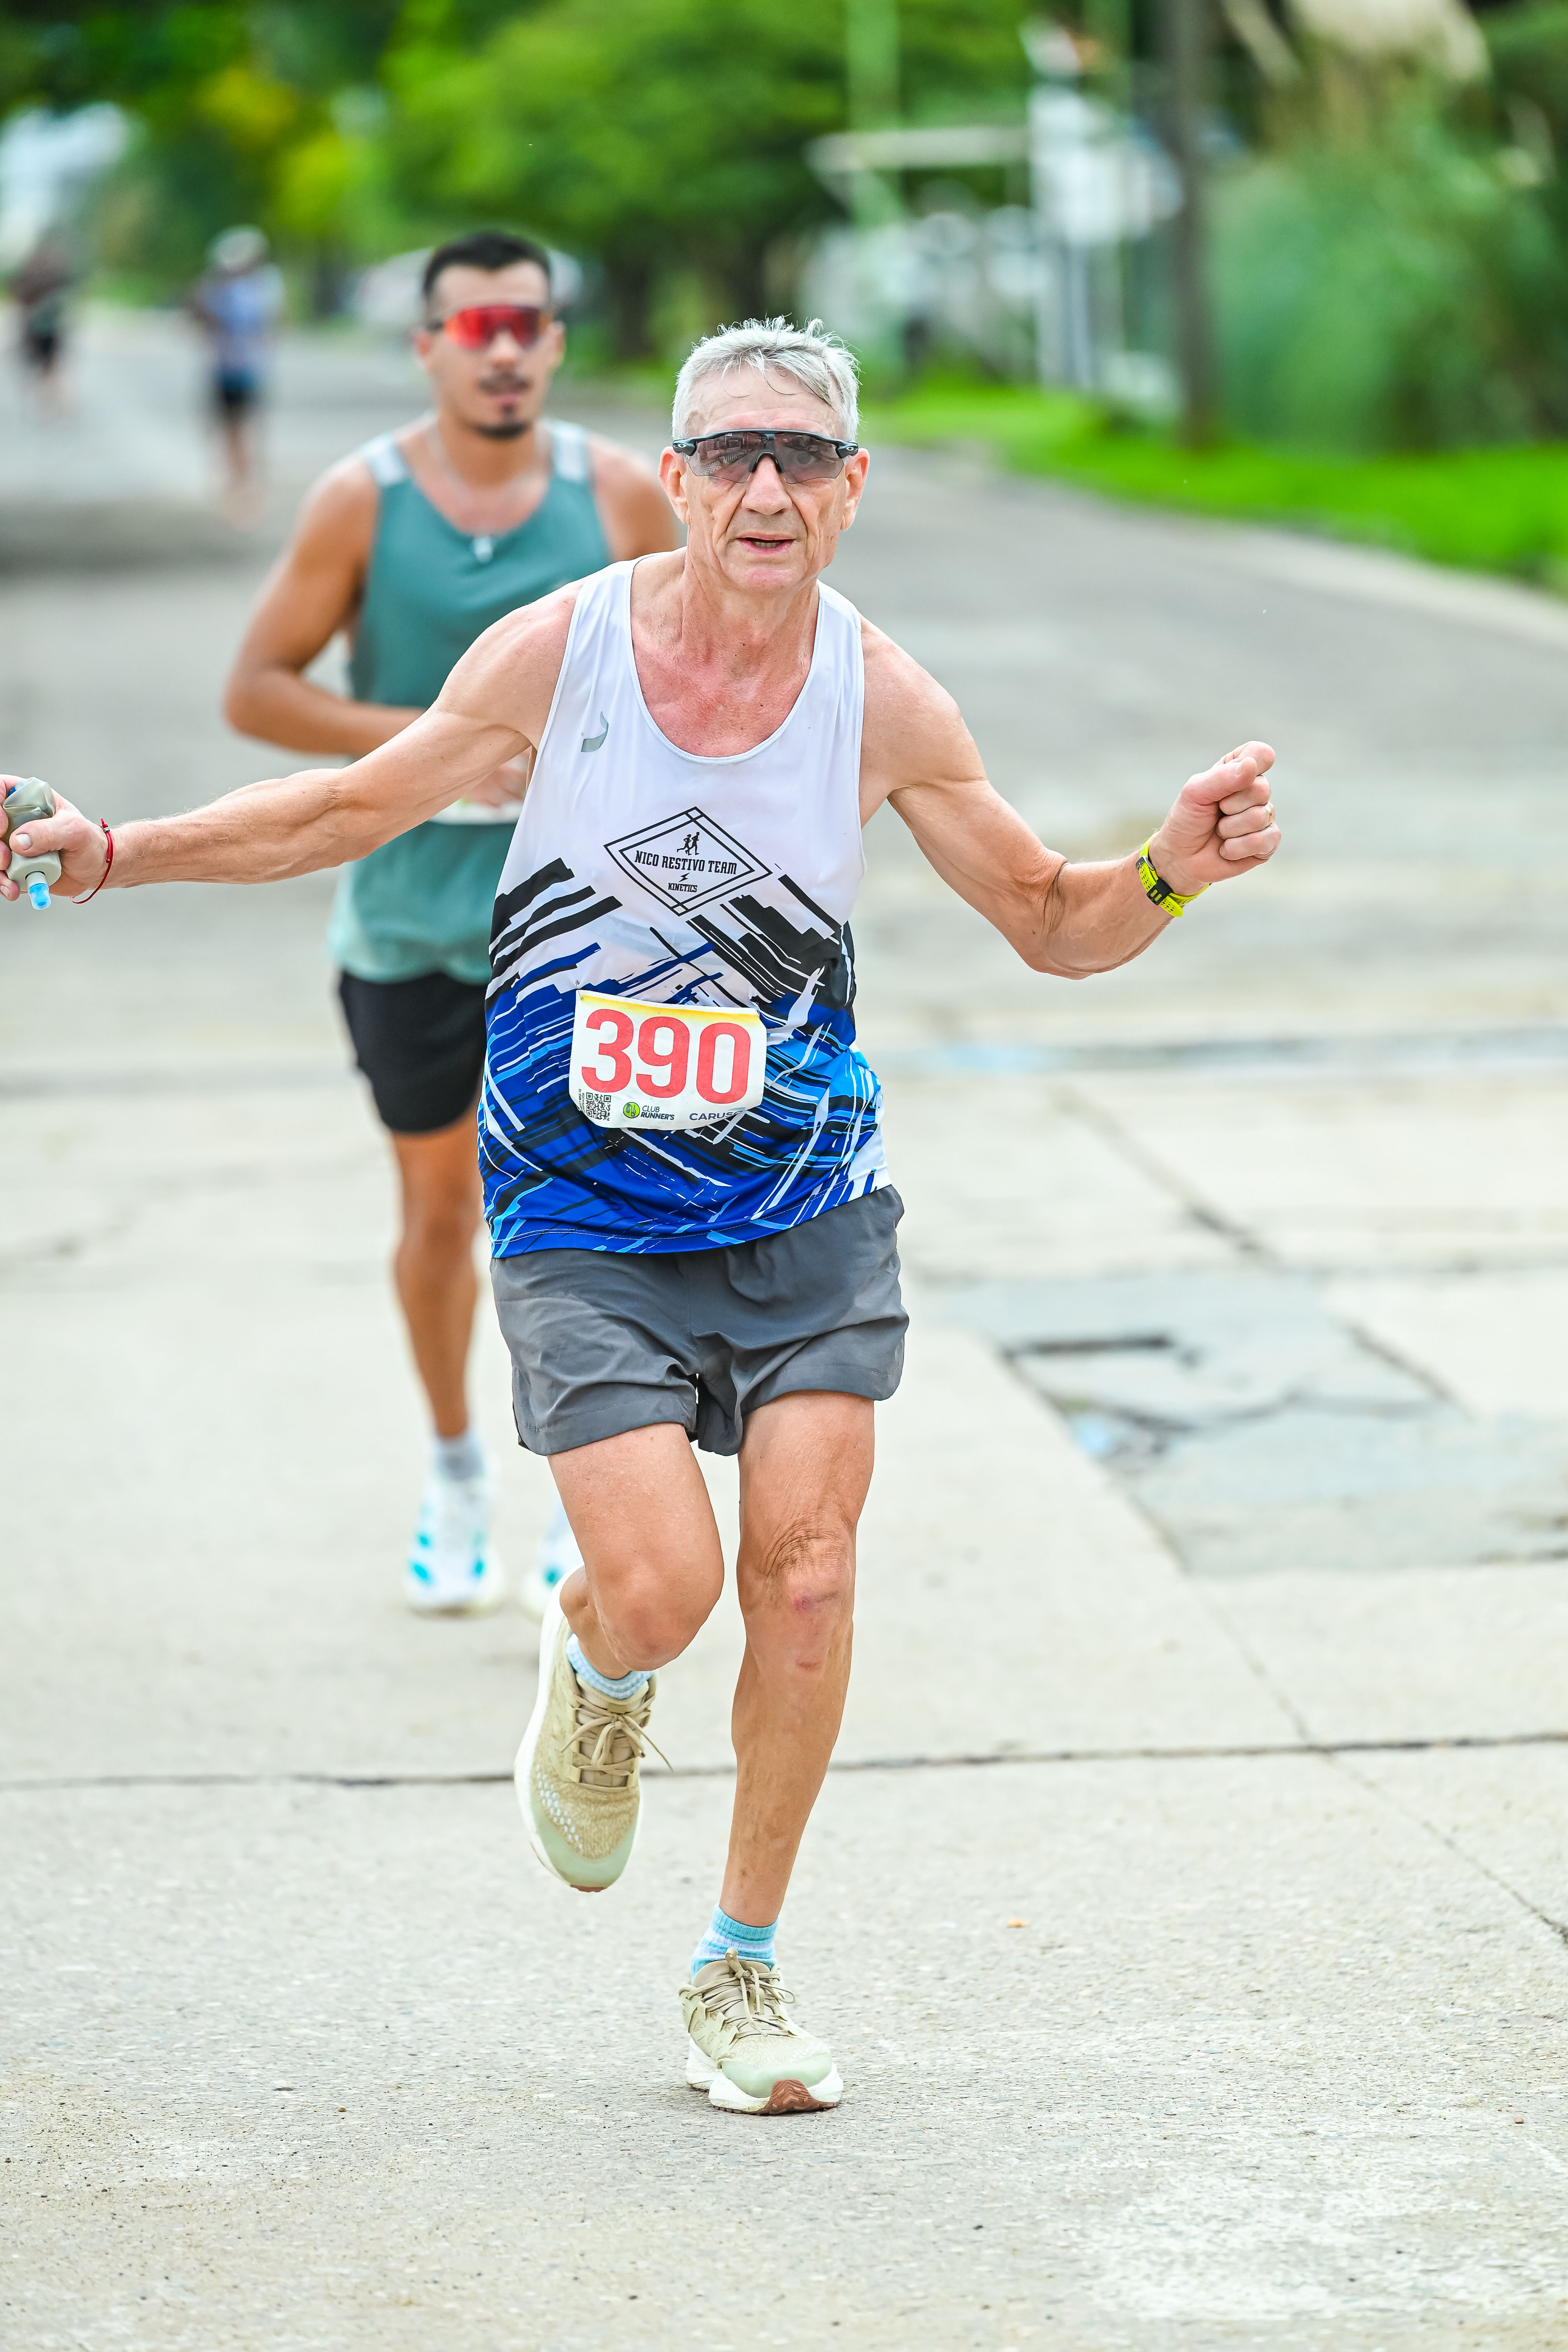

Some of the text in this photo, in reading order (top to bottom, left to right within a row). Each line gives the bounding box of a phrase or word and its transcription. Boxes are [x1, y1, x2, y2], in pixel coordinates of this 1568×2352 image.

[634, 850, 737, 875] NICO RESTIVO TEAM
[668, 883, 698, 892] KINETICS
[581, 1009, 751, 1104] 390
[640, 1112, 675, 1120] RUNNER'S
